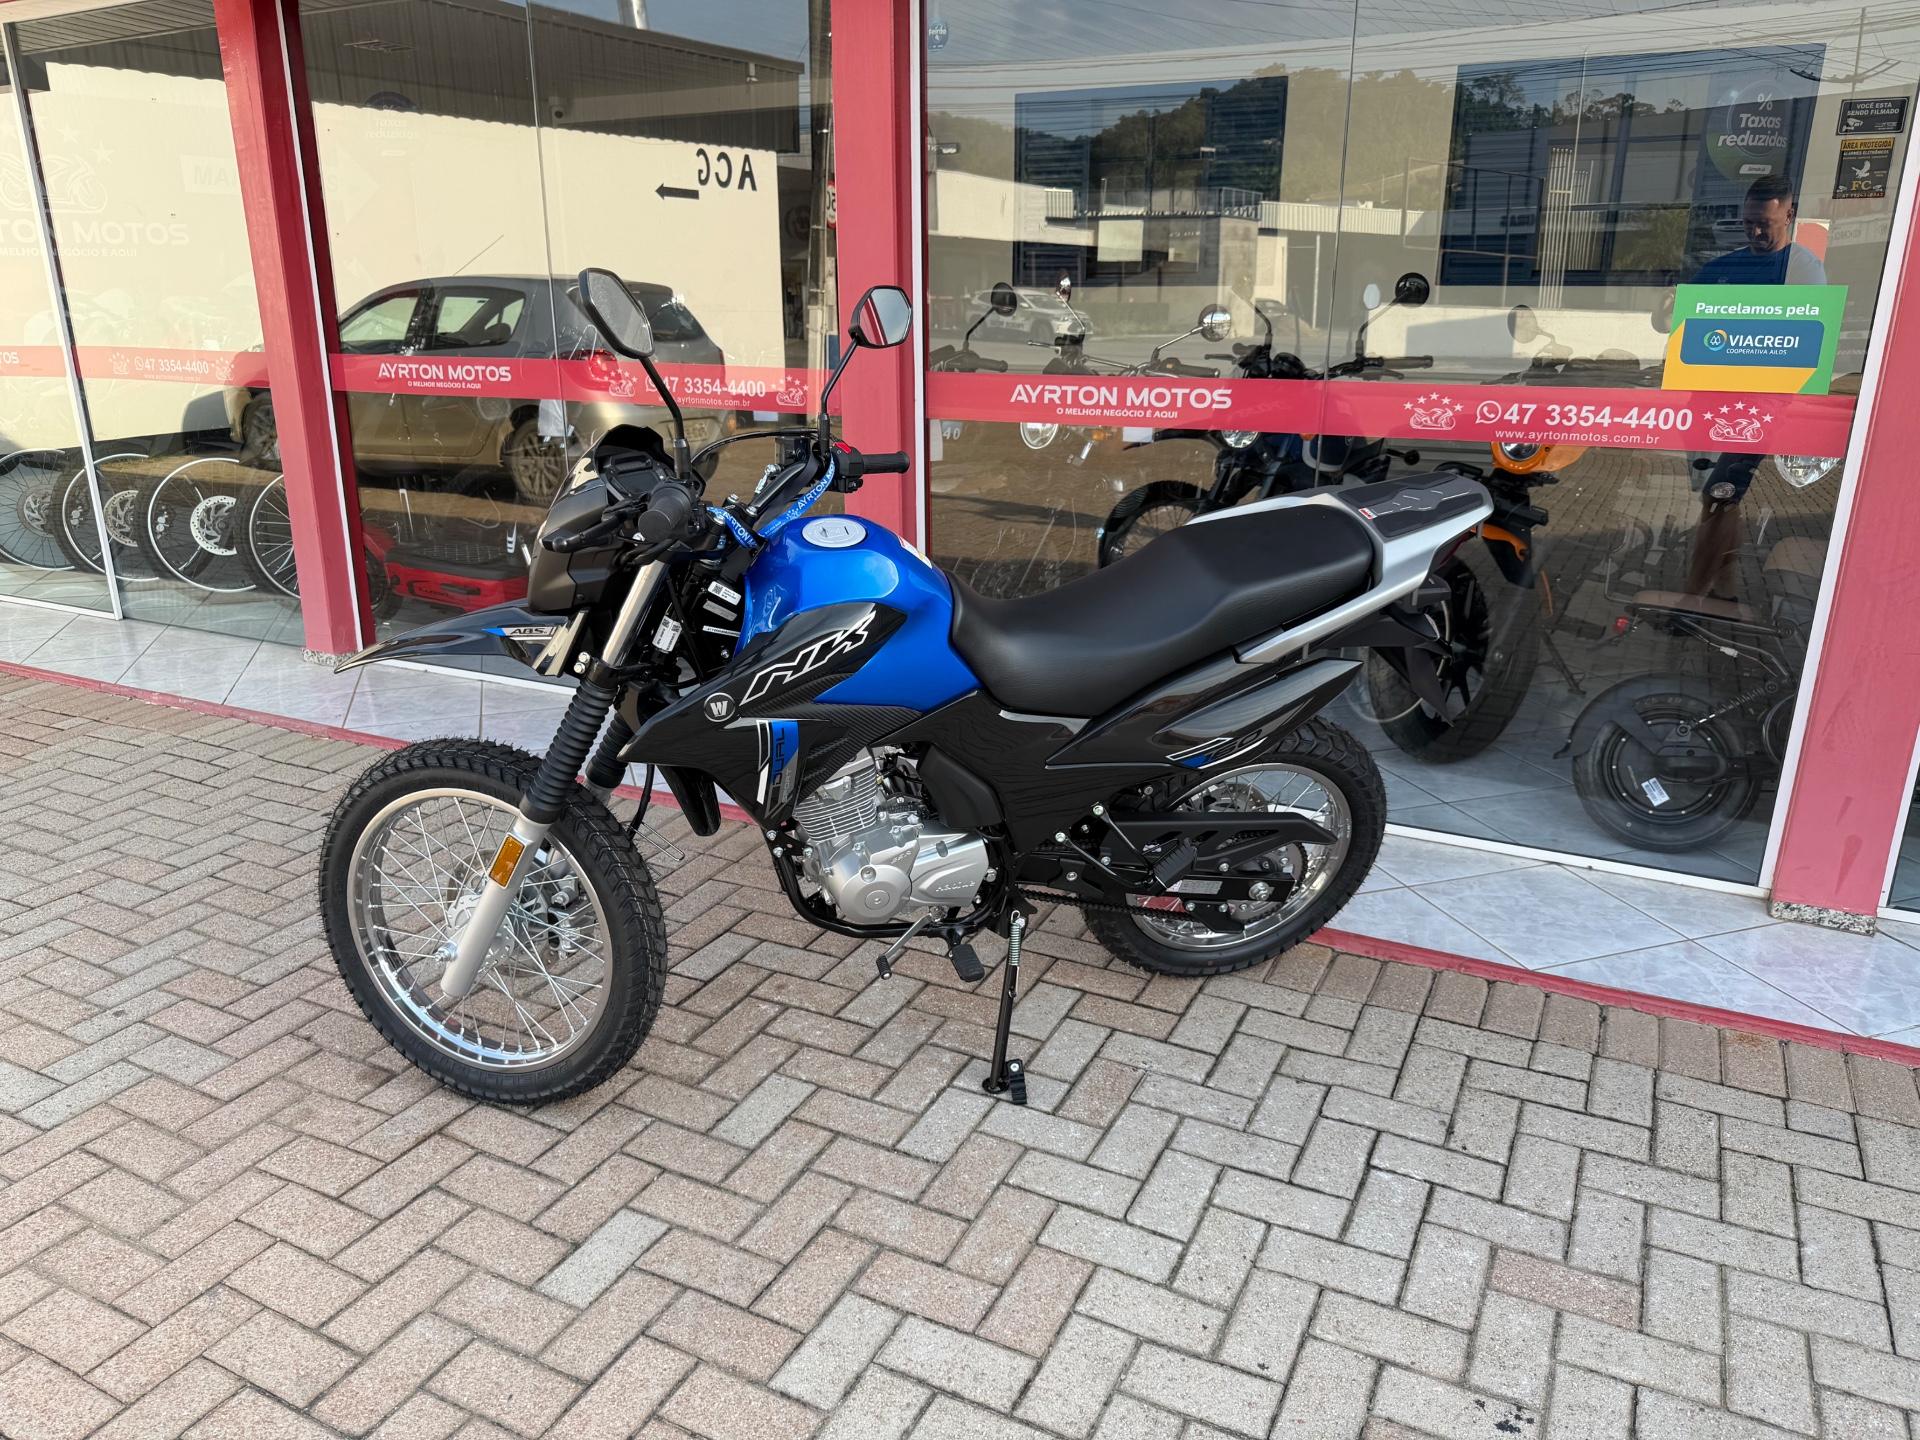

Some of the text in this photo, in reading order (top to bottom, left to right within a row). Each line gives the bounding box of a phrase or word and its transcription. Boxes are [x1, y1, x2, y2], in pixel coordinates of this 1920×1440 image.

[1875, 101, 1892, 109] ESTÁ
[1740, 113, 1781, 129] Taxas
[1718, 130, 1788, 148] reduzidas
[1860, 140, 1891, 148] PROTEGIDA
[1851, 180, 1872, 191] FC
[72, 219, 190, 246] MOTOS
[1696, 303, 1820, 317] Parcelamos pela
[1729, 334, 1800, 348] VIACREDI
[144, 358, 209, 374] 47 3354-4400
[378, 362, 512, 381] AYRTON MOTOS
[436, 381, 461, 389] NEGÓCIO
[684, 377, 766, 397] 3354-4400
[1009, 383, 1232, 409] AYRTON MOTOS
[1065, 408, 1101, 416] MELHOR
[1103, 407, 1144, 418] NEGÓCIO
[1146, 408, 1152, 418] É
[1153, 410, 1178, 419] AQUI
[1503, 403, 1693, 431] 47 3354-4400
[1495, 429, 1660, 445] www.ayrtonmotos.com.br
[797, 477, 829, 511] AYRTON
[723, 510, 751, 542] AYRTON
[773, 727, 785, 786] DUAL
